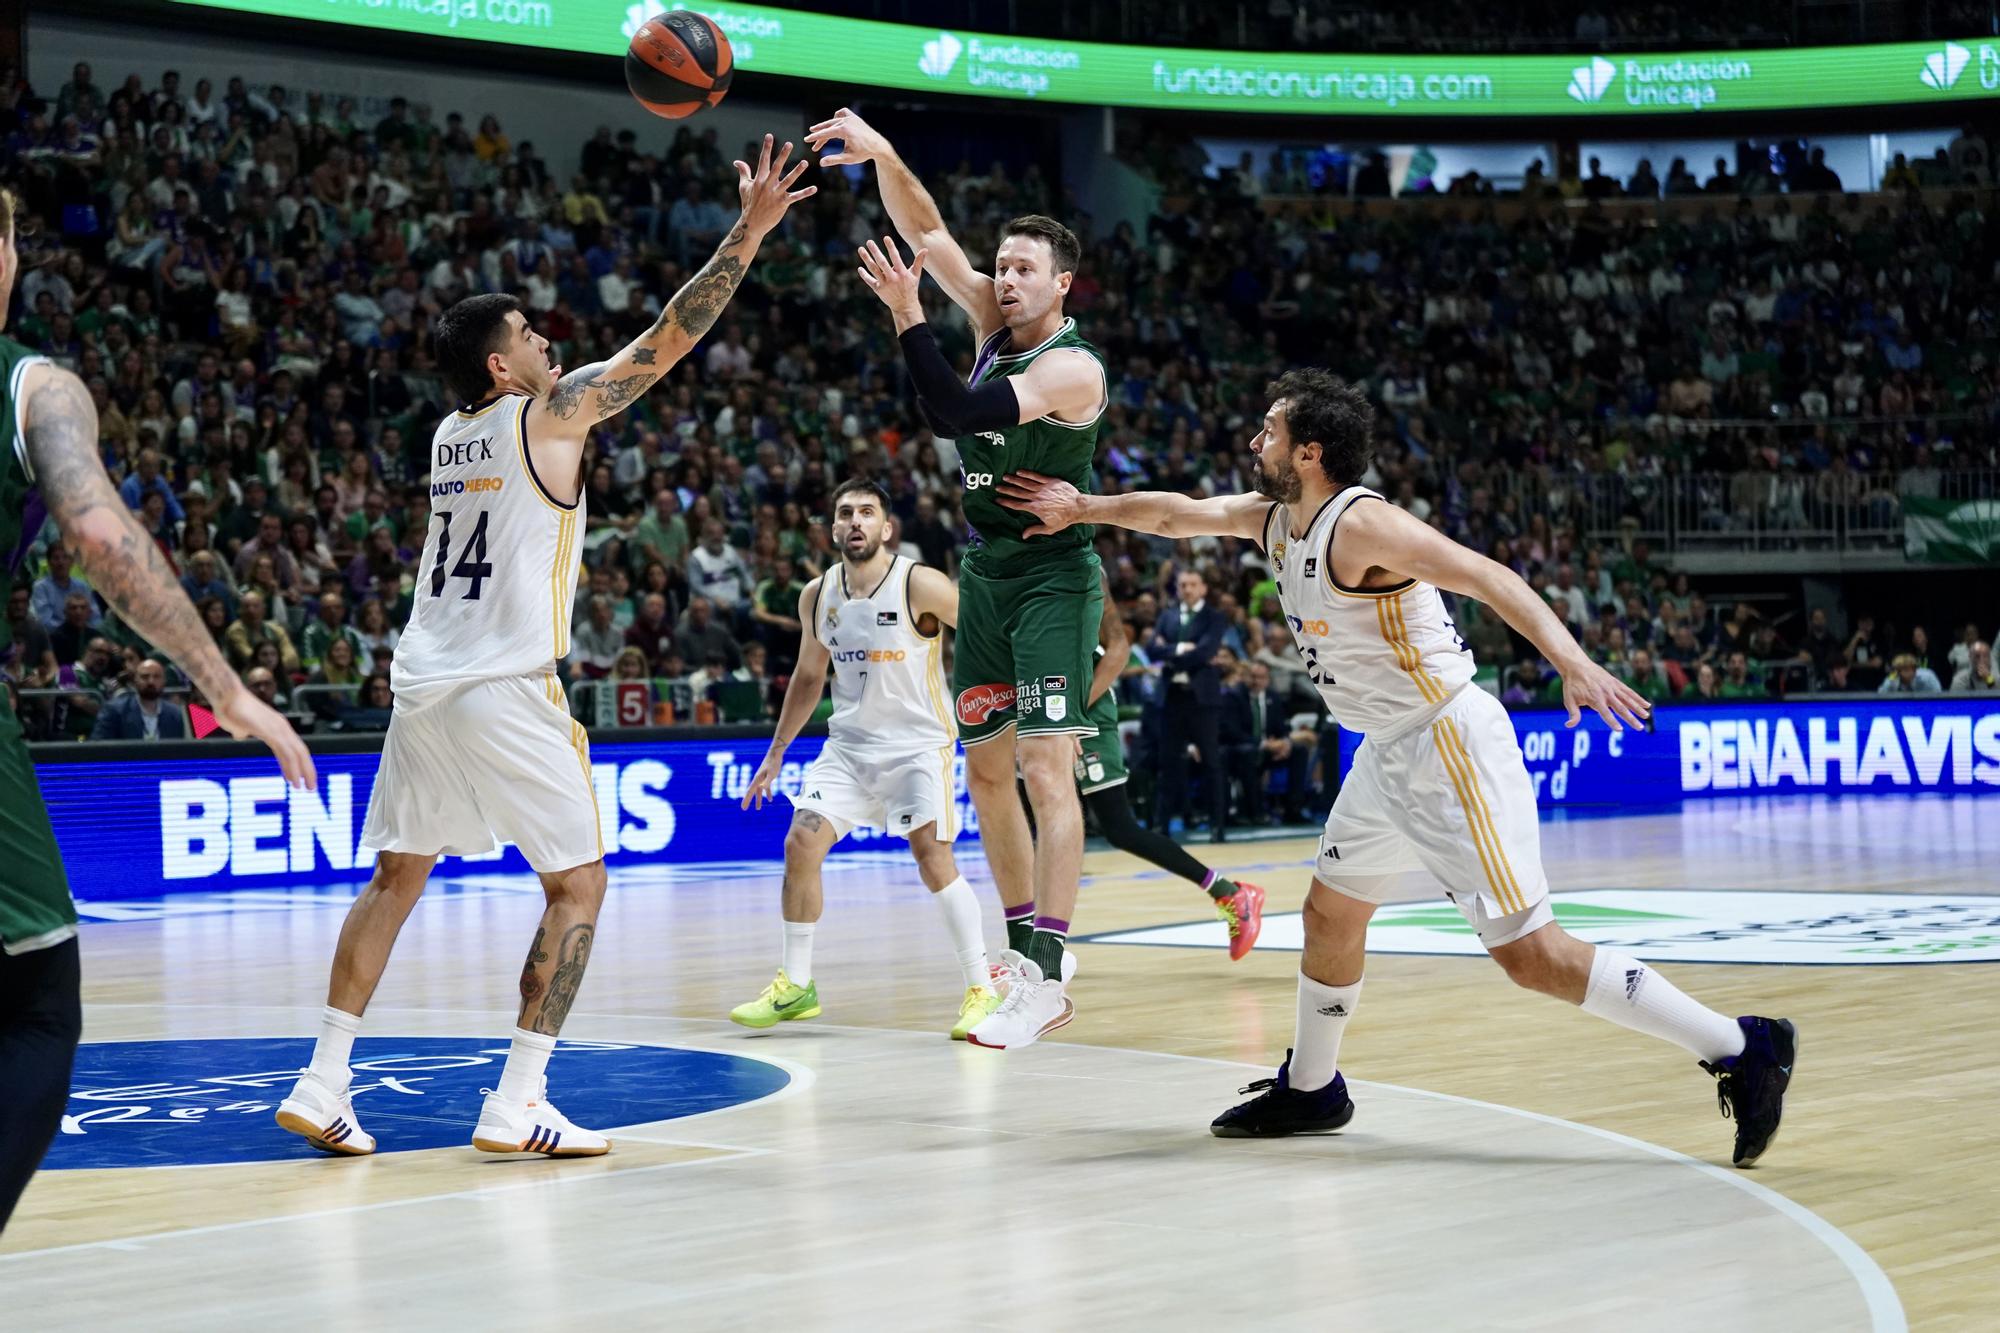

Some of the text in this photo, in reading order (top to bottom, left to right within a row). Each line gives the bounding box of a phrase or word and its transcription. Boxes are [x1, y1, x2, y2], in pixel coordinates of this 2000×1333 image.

[967, 63, 1048, 97] Unicaja
[1152, 60, 1492, 107] fundacionunicaja.com
[1624, 58, 1751, 81] Fundación
[1624, 82, 1716, 110] Unicaja
[438, 436, 494, 467] DECK
[432, 476, 504, 497] AUTOHERO
[430, 510, 493, 600] 14
[622, 690, 643, 722] 5
